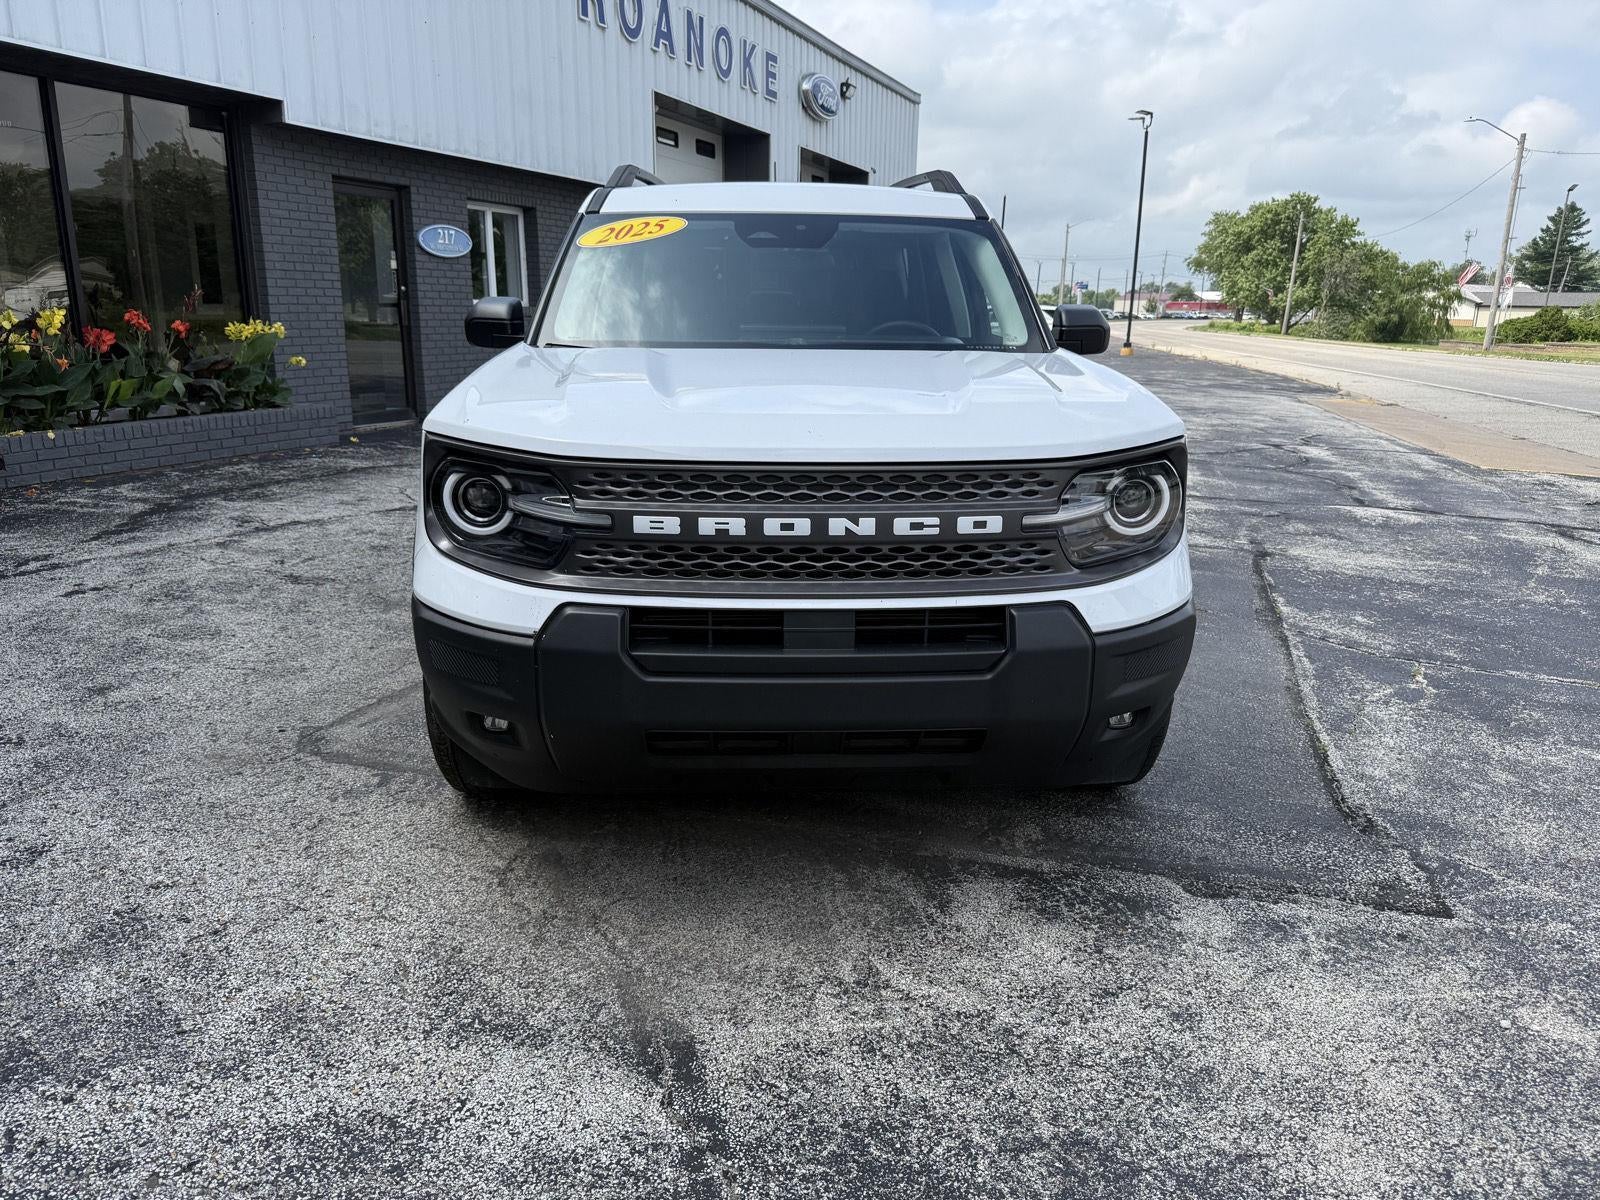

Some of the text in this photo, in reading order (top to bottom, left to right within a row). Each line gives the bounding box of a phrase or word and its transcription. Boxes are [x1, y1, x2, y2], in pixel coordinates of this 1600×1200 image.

[817, 82, 838, 113] Ford
[438, 229, 456, 245] 217
[595, 219, 670, 245] 2025
[632, 514, 1003, 536] BRONCO
